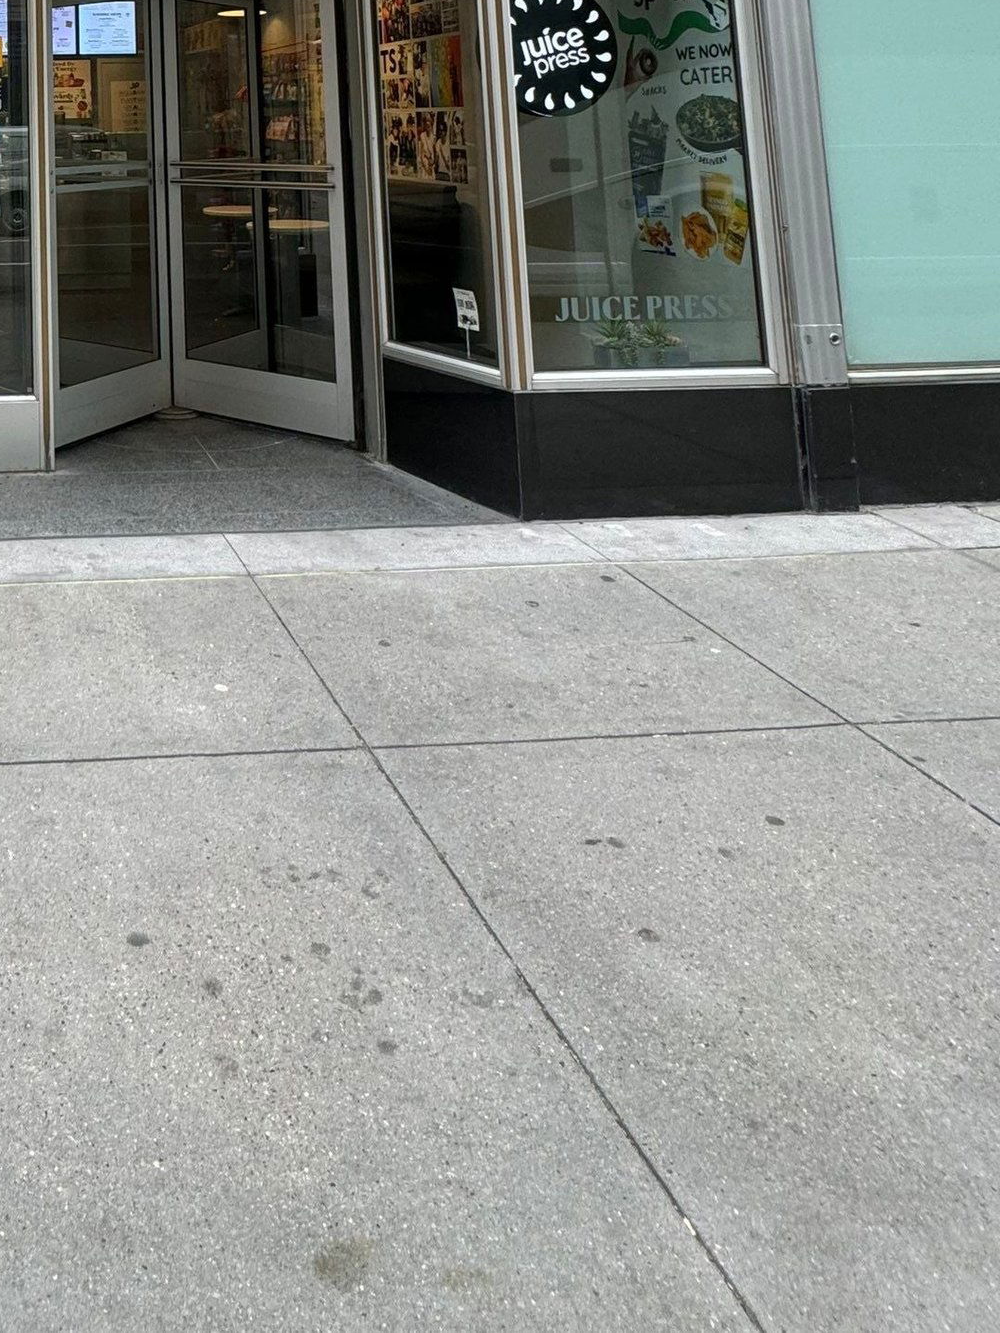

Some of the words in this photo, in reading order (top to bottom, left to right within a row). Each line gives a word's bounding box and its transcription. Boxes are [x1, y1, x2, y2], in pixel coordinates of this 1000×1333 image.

[533, 47, 590, 79] press
[675, 47, 697, 61] WE
[699, 42, 732, 60] NOW
[680, 65, 733, 86] CATER
[555, 296, 641, 322] JUICE
[646, 294, 734, 320] PRESS
